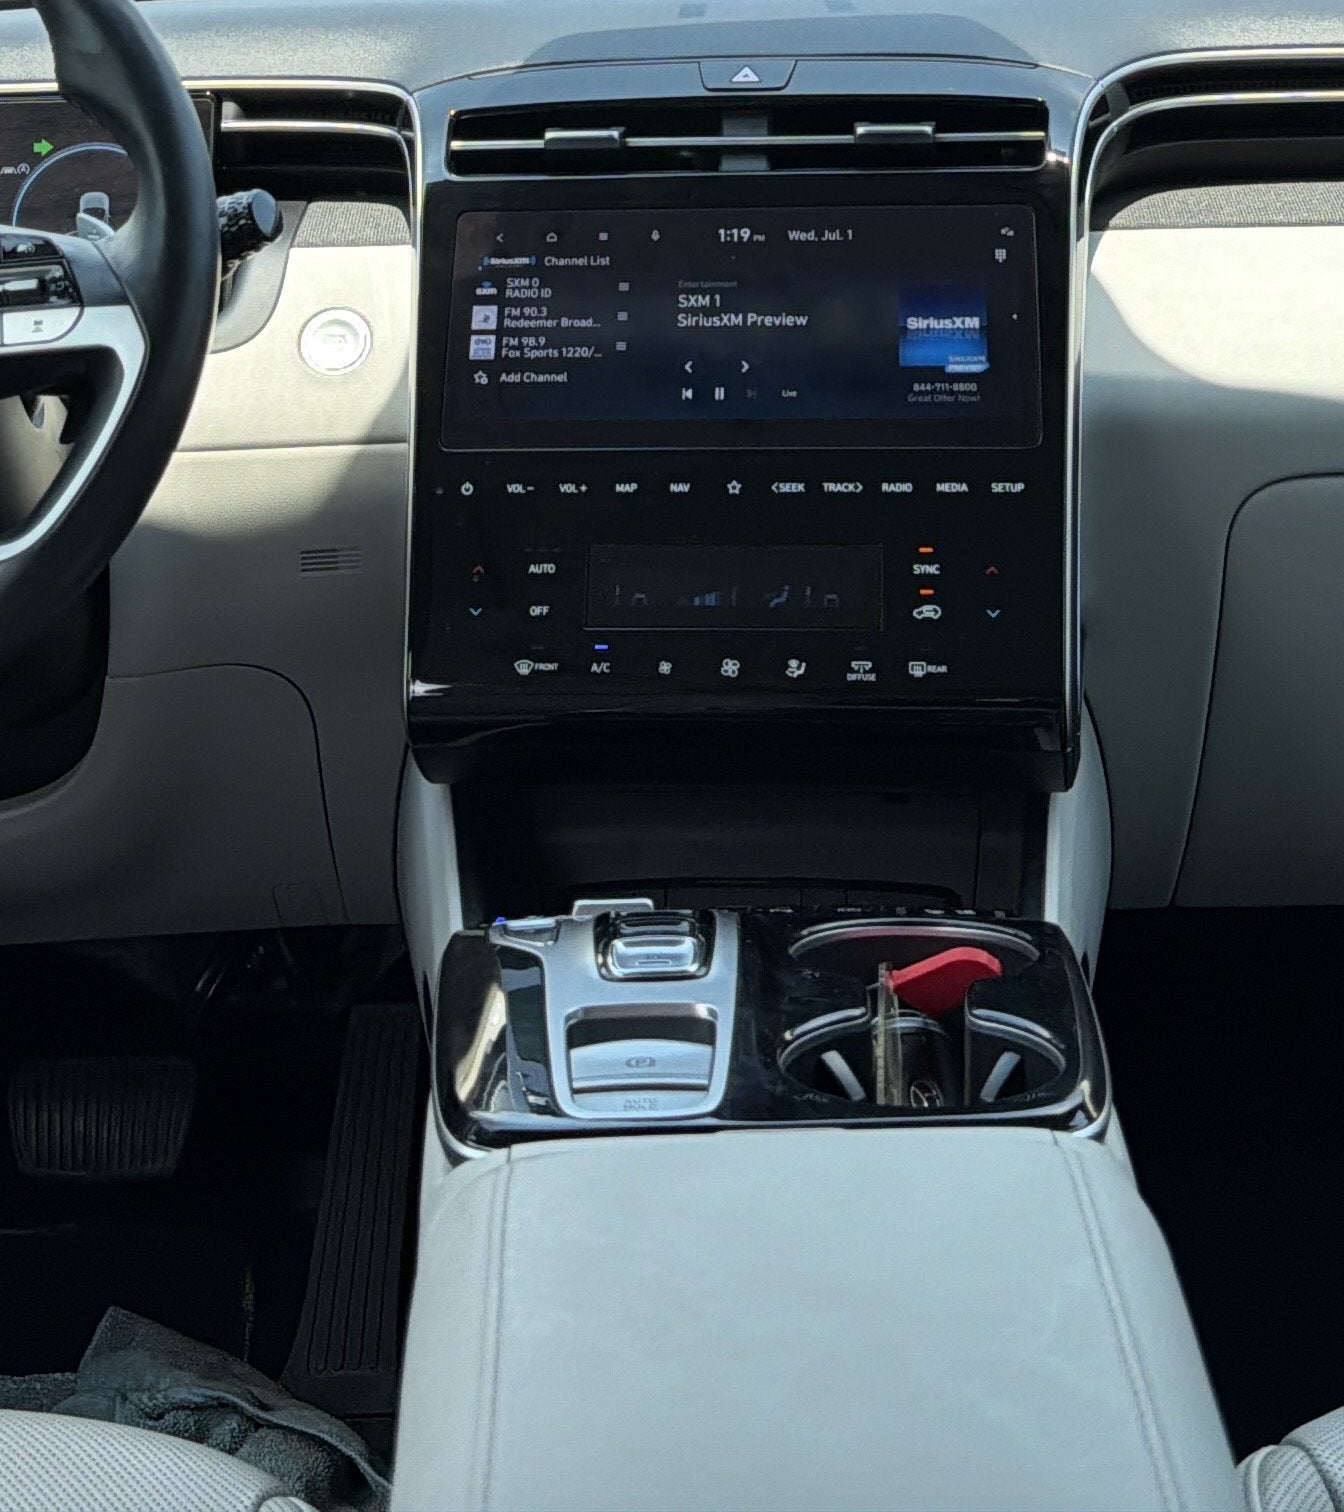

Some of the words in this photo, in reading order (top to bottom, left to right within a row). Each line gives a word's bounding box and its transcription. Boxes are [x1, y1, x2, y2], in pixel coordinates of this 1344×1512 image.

[718, 227, 751, 242] 1:19
[753, 234, 766, 242] PM
[821, 229, 844, 241] Jul.
[847, 229, 854, 241] 1
[544, 255, 588, 267] Channel
[590, 255, 610, 267] List
[506, 277, 530, 288] SXM
[505, 288, 539, 299] RADIO
[541, 288, 553, 299] ID
[677, 294, 711, 308] SXM
[714, 294, 721, 308] 1
[504, 307, 521, 318] FM
[523, 307, 548, 318] 90.3
[503, 317, 557, 328] Redeemer
[676, 312, 744, 328] SiriusXM
[746, 312, 809, 327] Preview
[906, 316, 980, 329] SiriusXM
[501, 336, 519, 347] FM
[521, 336, 546, 347] 98.9
[501, 347, 521, 358] Fox
[523, 347, 559, 360] Sports
[499, 371, 521, 383] Add
[523, 371, 568, 383] Channel
[615, 482, 639, 493] MAP
[670, 482, 691, 493] NAV
[881, 482, 913, 493] RADIO
[936, 482, 969, 493] MEDIA
[991, 482, 1025, 493] SETUP
[528, 563, 557, 574] AUTO
[912, 563, 941, 575] SYNC
[529, 605, 550, 617] OFF
[534, 662, 559, 671] FRONT
[590, 661, 611, 674] A/C
[927, 665, 948, 674] REAR
[846, 673, 877, 682] DIFFUSE
